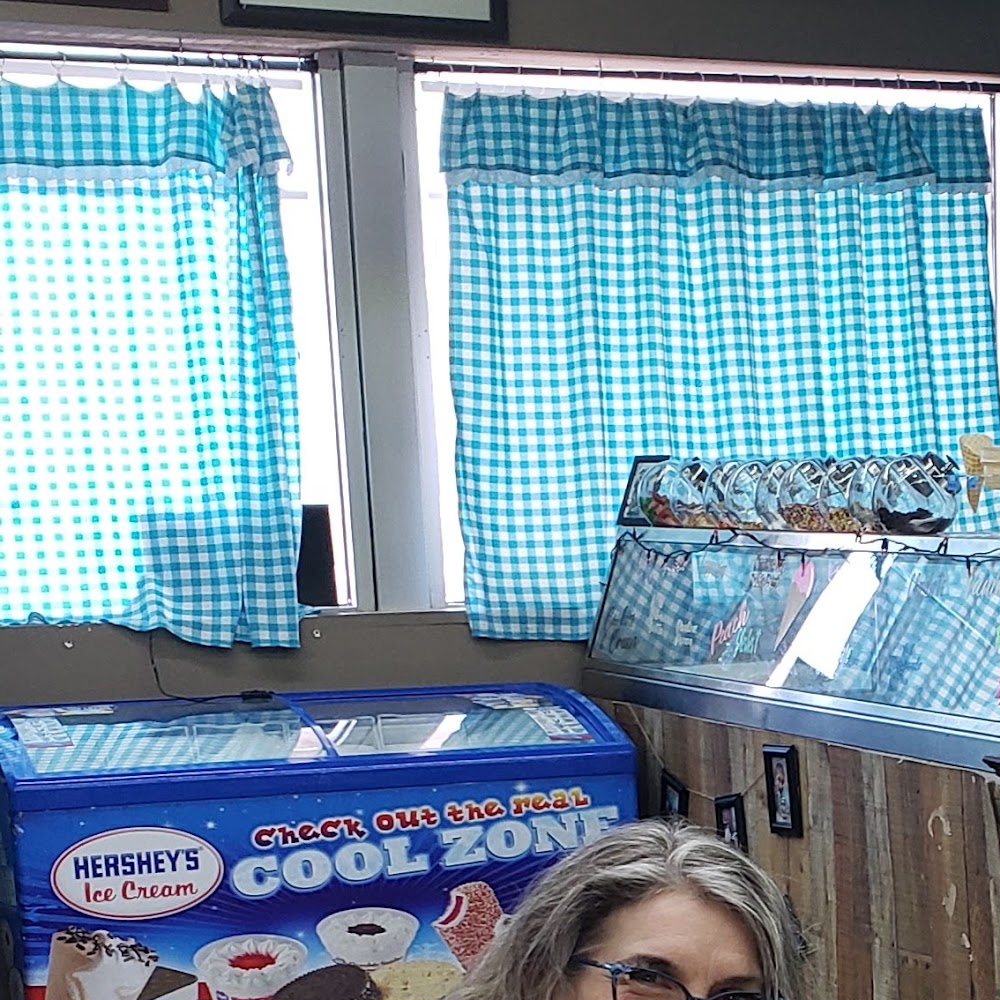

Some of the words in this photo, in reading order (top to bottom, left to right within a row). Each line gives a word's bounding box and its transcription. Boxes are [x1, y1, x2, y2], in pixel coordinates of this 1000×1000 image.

[253, 817, 366, 848] Check
[375, 805, 439, 831] out
[447, 796, 505, 822] the
[512, 787, 590, 816] real
[73, 847, 201, 880] HERSHEY'S
[231, 836, 430, 897] COOL
[84, 882, 117, 903] Ice
[121, 880, 198, 900] Cream
